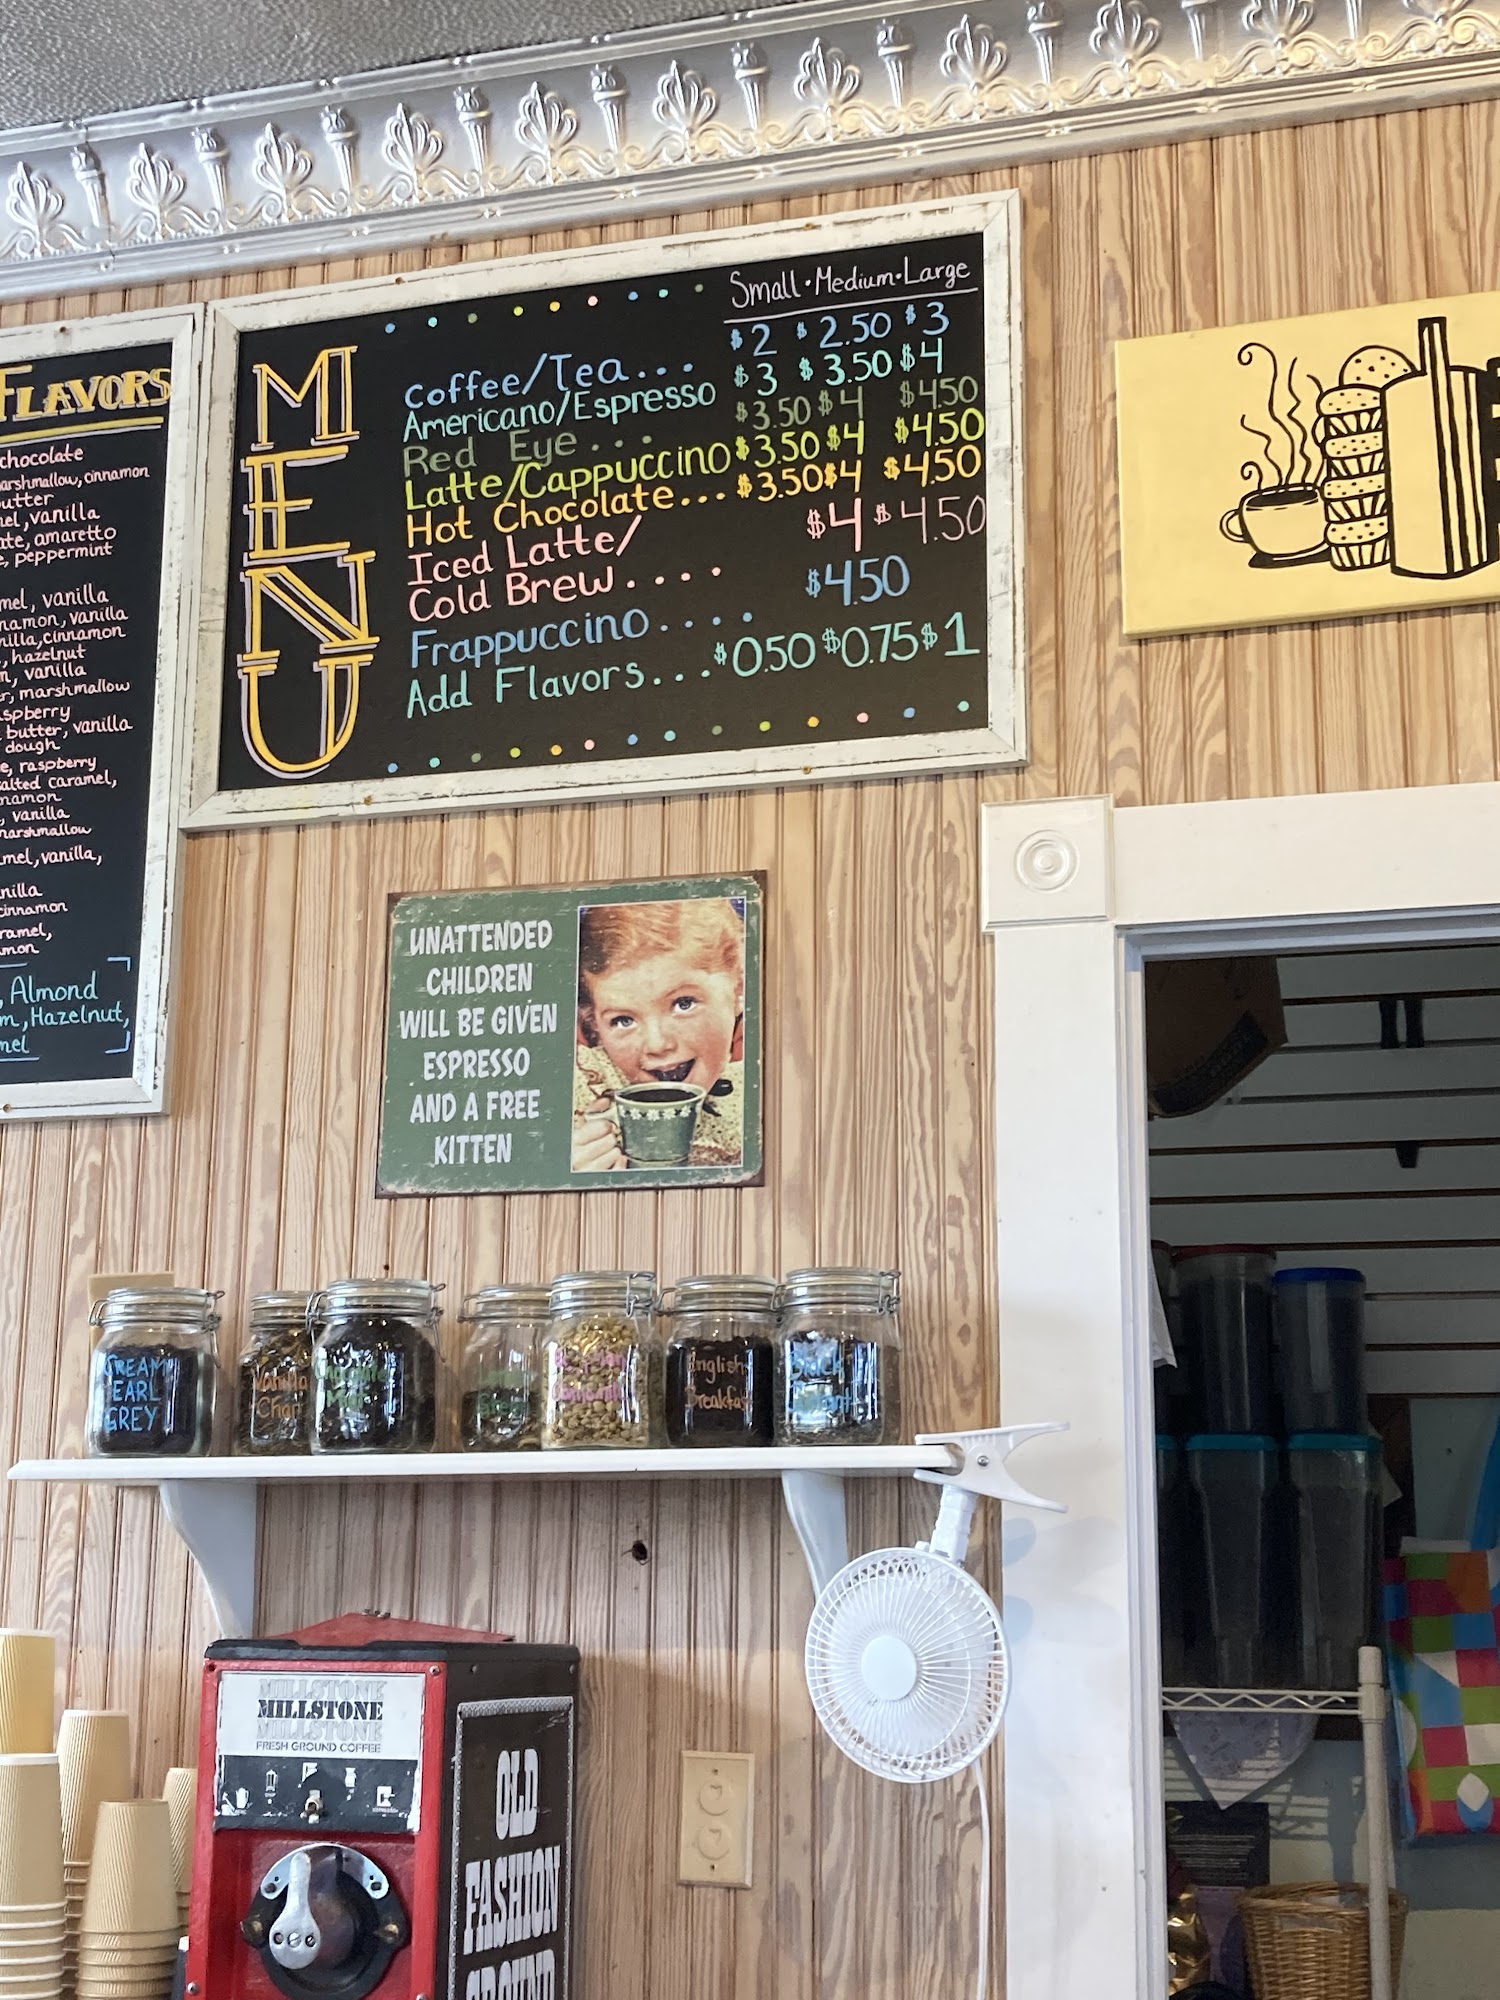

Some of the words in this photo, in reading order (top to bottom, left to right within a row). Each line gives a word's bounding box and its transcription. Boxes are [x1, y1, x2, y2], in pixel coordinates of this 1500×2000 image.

[403, 381, 717, 442] Americano/Espresso
[403, 436, 477, 478] Red
[735, 396, 811, 431] $3.50
[819, 386, 863, 419] $4
[405, 442, 731, 510] Latte/Cappuccino
[735, 431, 820, 468] $3.50
[827, 420, 864, 456] $4
[894, 407, 985, 447] $4.50
[0, 491, 54, 510] utter
[406, 505, 474, 548] Hot
[737, 464, 823, 501] $3.50
[824, 459, 862, 493] $4
[884, 444, 981, 488] $4.50
[34, 526, 117, 547] amaretto
[407, 540, 494, 586] Iced
[505, 514, 642, 570] Latte/
[807, 497, 862, 553] $4
[874, 495, 986, 544] $4.50
[15, 542, 113, 567] peppermint
[237, 346, 381, 779] MENU
[805, 555, 911, 606] $4.50
[42, 583, 109, 609] vanilla
[409, 578, 492, 623] Cold
[69, 606, 128, 626] vanilla
[12, 645, 86, 665] hazelnut
[406, 670, 473, 719] Add
[822, 621, 919, 668] $0.75
[920, 611, 980, 656] $1
[24, 662, 86, 681] vanilla
[19, 680, 130, 701] marshmallow
[0, 705, 70, 725] spberry
[6, 723, 68, 739] butter,
[72, 715, 133, 735] vanilla
[5, 737, 61, 755] dough
[19, 756, 97, 775] raspberry
[48, 771, 118, 790] caramel,
[12, 805, 70, 822] vanilla
[410, 919, 553, 956] UNATTENDED
[10, 970, 99, 1005] Almond
[426, 962, 533, 996] CHILDREN
[400, 1009, 450, 1039] WILL
[457, 1007, 485, 1037] BE
[491, 1003, 557, 1035] GIVEN
[424, 1047, 530, 1081] ESPRESSO
[410, 1093, 457, 1123] AND
[464, 1092, 479, 1122] A
[487, 1089, 541, 1121] FREE
[435, 1133, 512, 1165] KITTEN
[113, 1380, 161, 1401] EARL
[104, 1405, 159, 1432] GREY
[259, 1678, 387, 1700] MILLSTONE
[258, 1699, 383, 1721] MILLSTONE
[256, 1719, 382, 1742] MILLSTONE
[256, 1740, 290, 1752] FRESH
[291, 1741, 337, 1753] GROUND
[339, 1742, 382, 1754] COFFEE
[495, 1748, 540, 1841] OLD
[462, 1845, 561, 1955] FASHION
